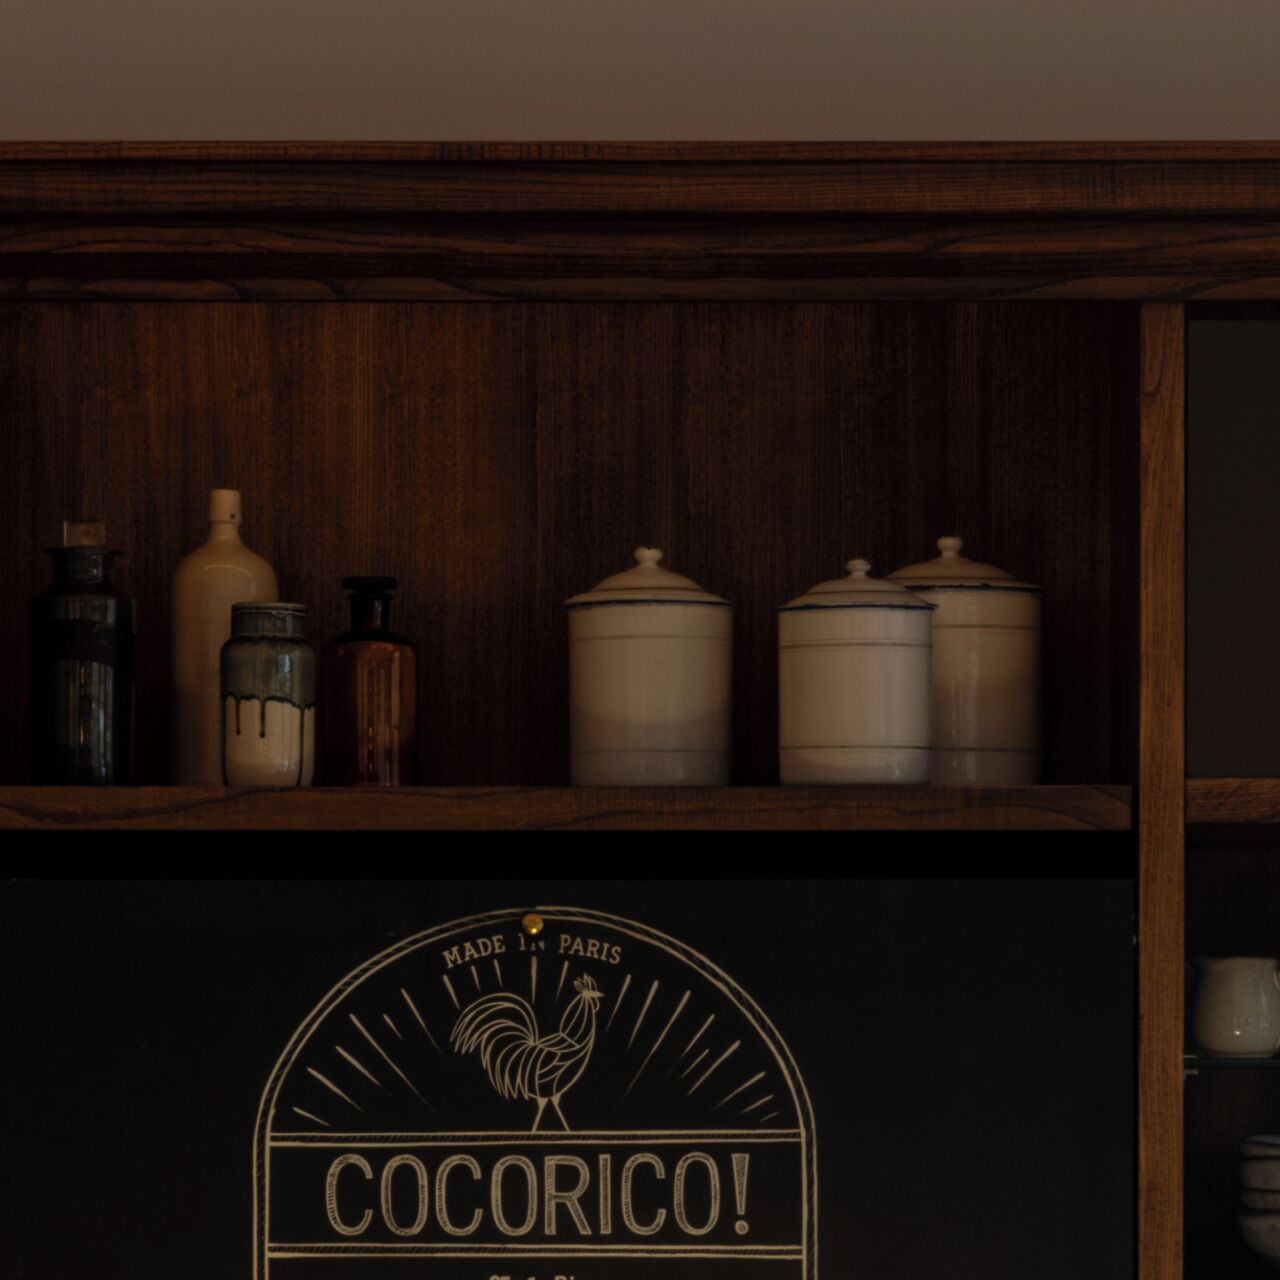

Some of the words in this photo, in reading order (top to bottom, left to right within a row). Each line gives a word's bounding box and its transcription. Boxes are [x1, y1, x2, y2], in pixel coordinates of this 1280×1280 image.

[442, 934, 506, 968] MADE
[558, 933, 621, 964] PARIS
[326, 1152, 750, 1236] COCORICO!
